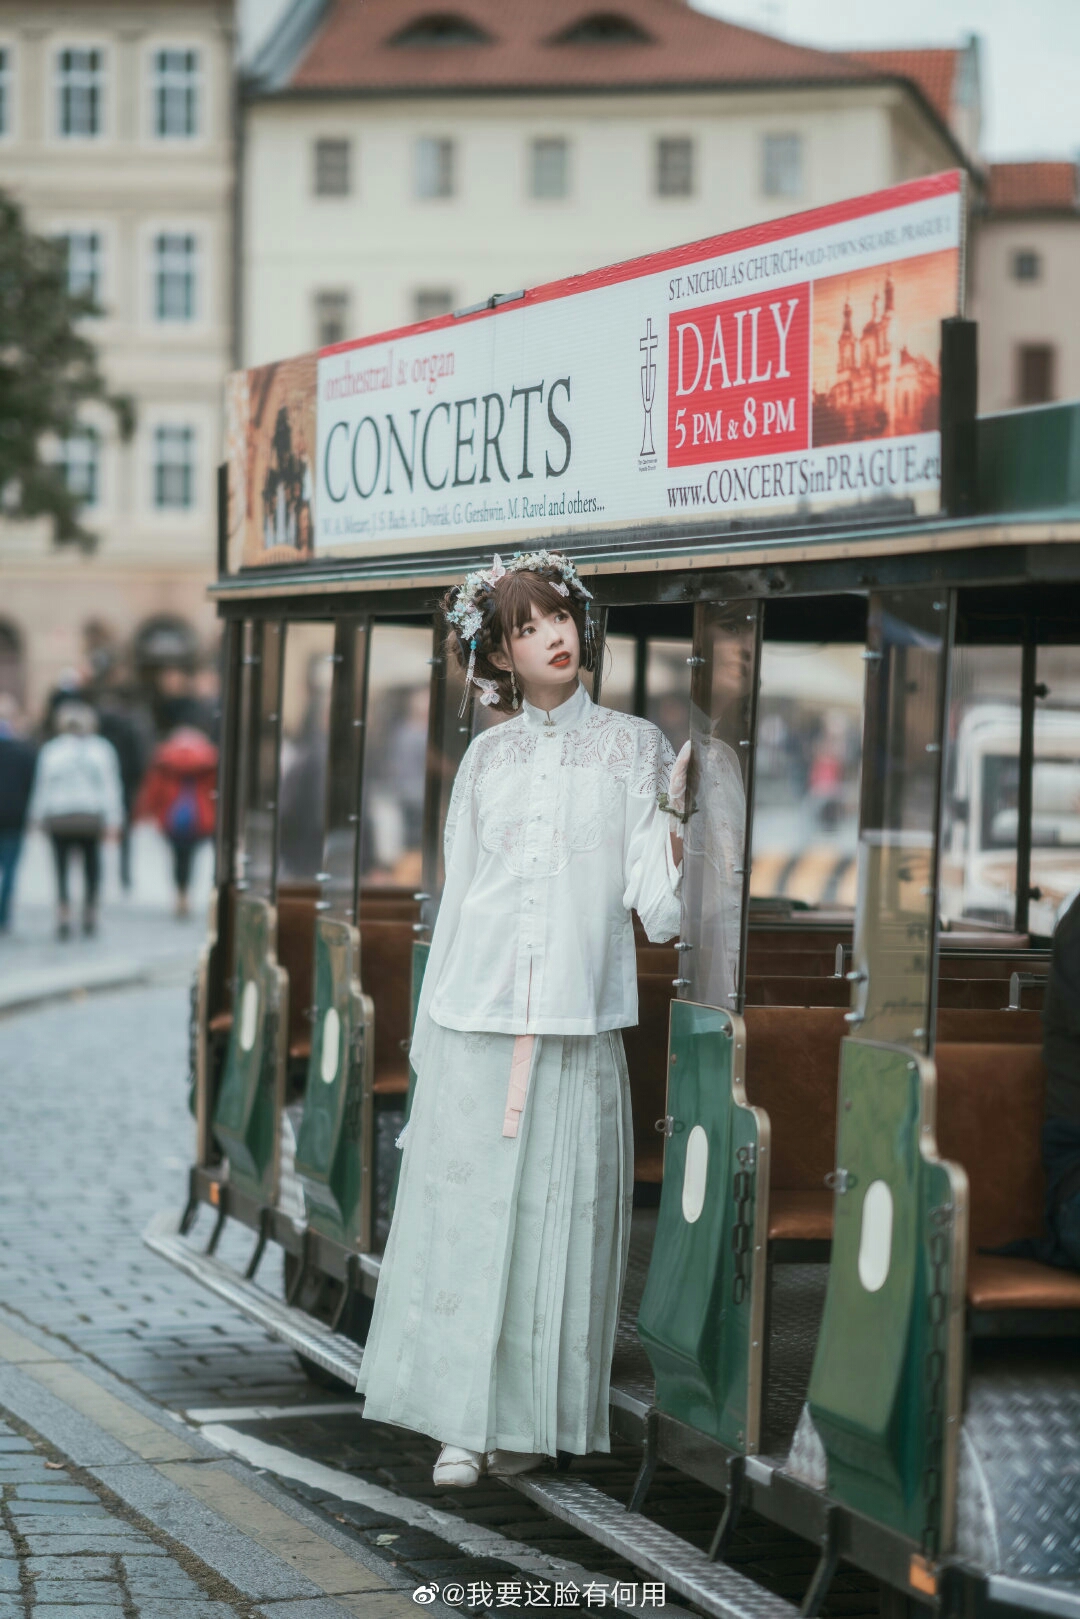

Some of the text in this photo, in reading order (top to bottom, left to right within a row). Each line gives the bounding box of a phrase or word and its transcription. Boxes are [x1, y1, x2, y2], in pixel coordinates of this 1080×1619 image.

[668, 277, 685, 301] ST.
[687, 261, 744, 296] NICHOLAS
[746, 248, 799, 281] CHURCH
[675, 298, 799, 397] DAILY
[325, 348, 455, 401] orchestral & organ
[324, 375, 572, 503] CONCERTS
[675, 396, 796, 449] 5 PM & 8 PM
[453, 503, 464, 525] G.
[464, 500, 506, 523] Gershwin,
[507, 497, 520, 520] M.
[522, 494, 547, 518] Ravel
[548, 492, 565, 516] and
[567, 490, 605, 514] others...
